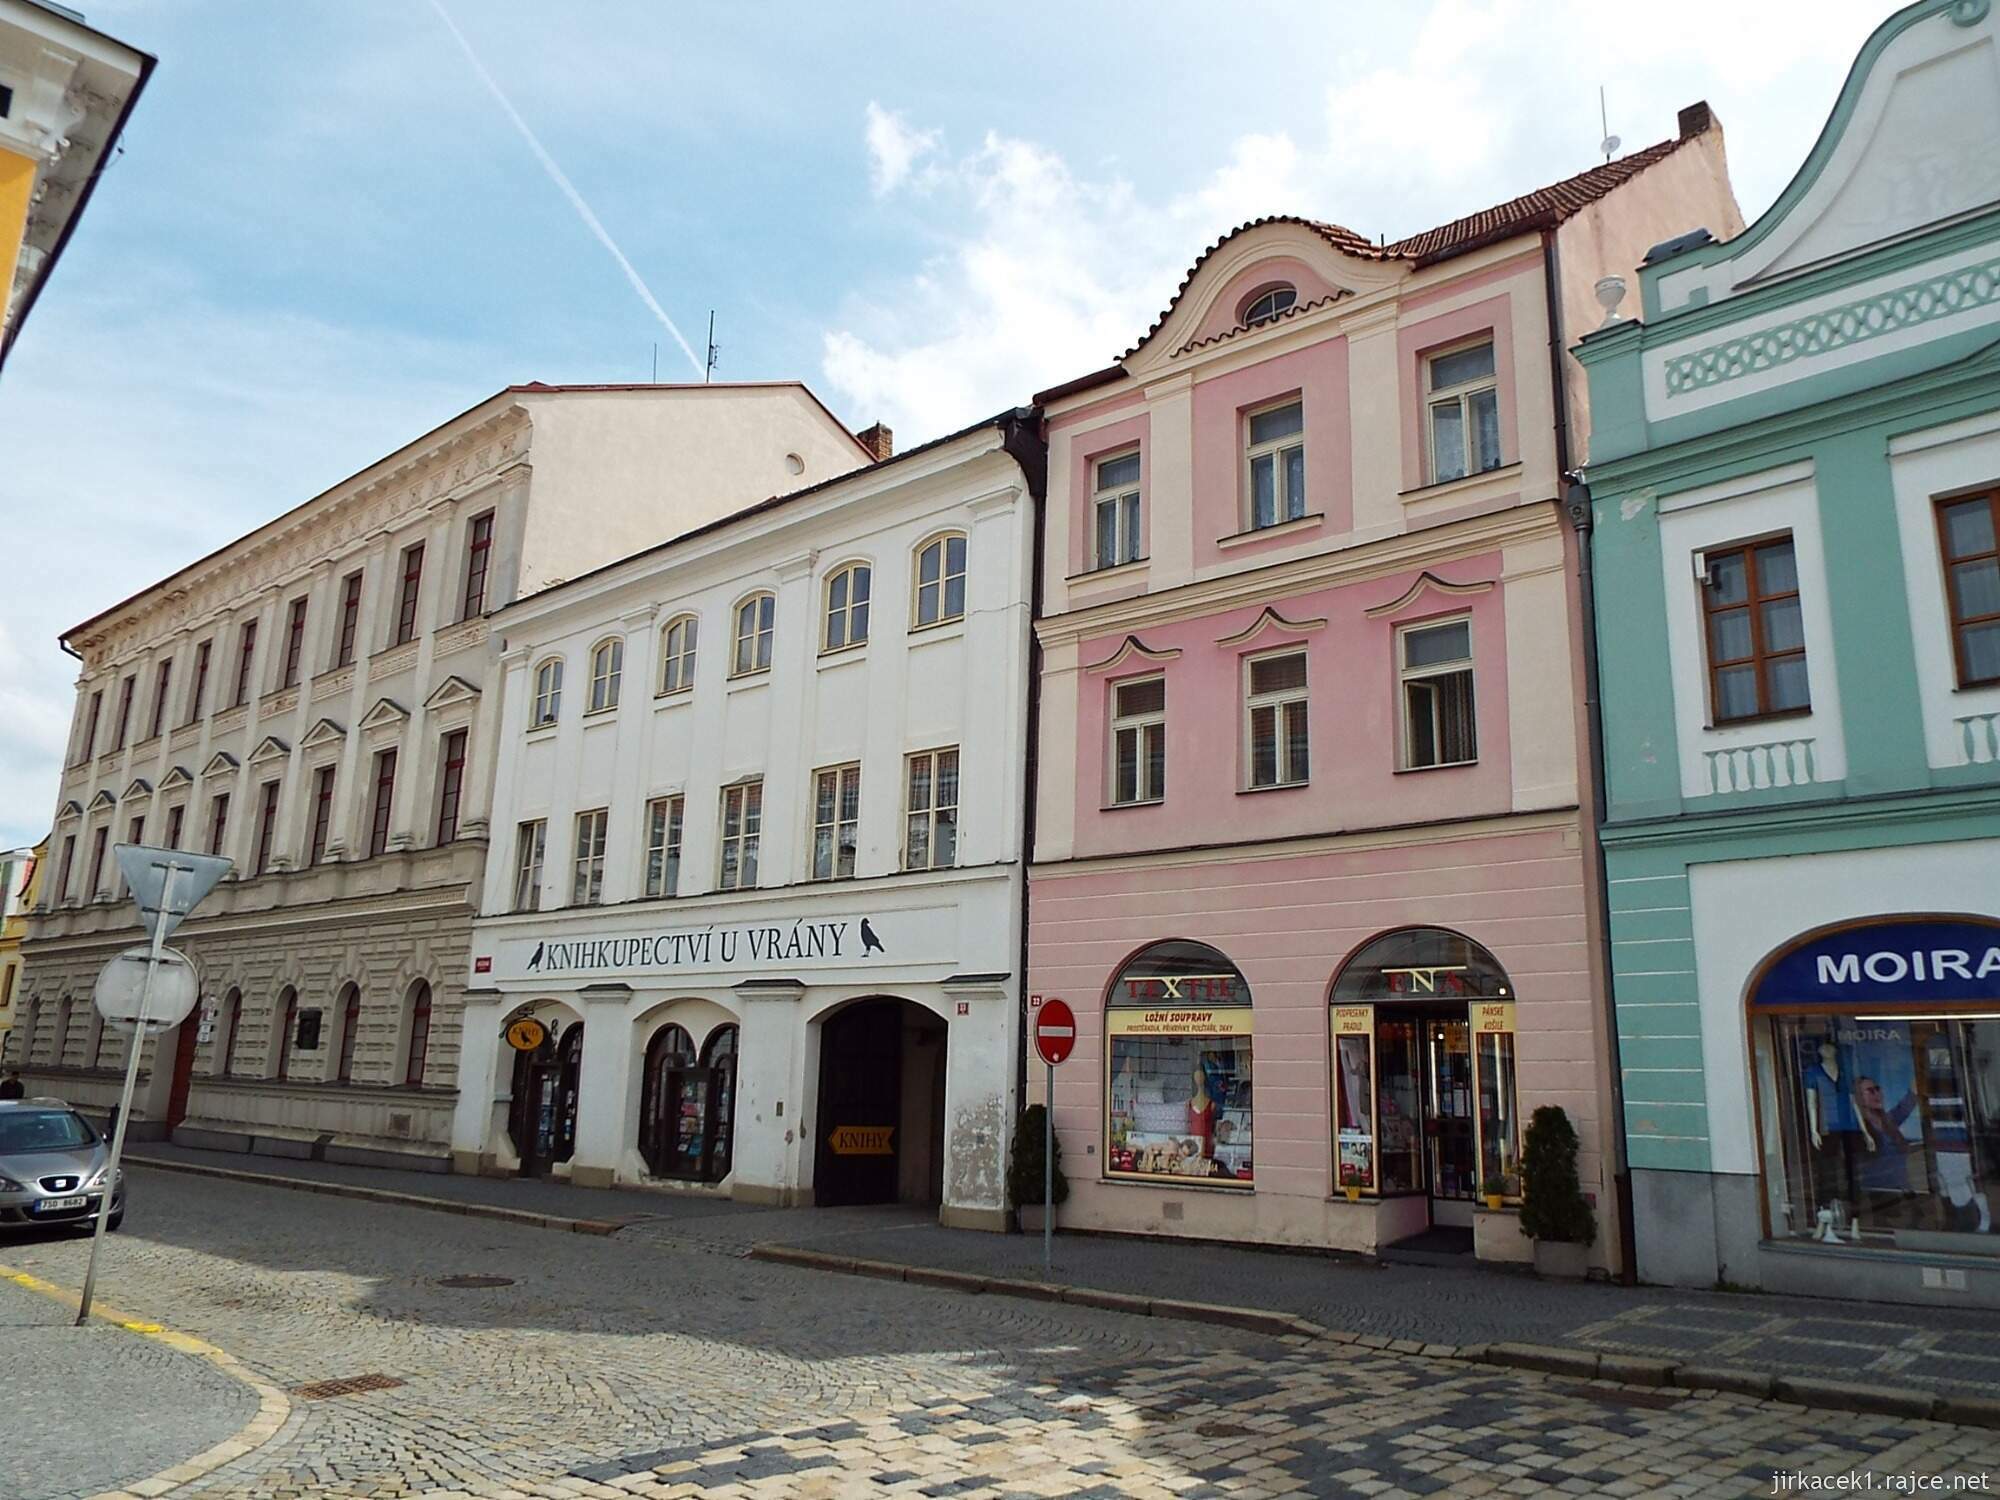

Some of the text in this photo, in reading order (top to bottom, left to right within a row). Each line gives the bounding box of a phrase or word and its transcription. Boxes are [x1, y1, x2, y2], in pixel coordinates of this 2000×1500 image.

[546, 918, 848, 970] KNIHKUPECTVÍ U VRÁNY
[1124, 976, 1236, 1000] TEXTIL
[1386, 969, 1464, 993] ENA
[1145, 1011, 1213, 1023] LOŽNÍ SOUPRAVY
[839, 1131, 886, 1149] KNIHY
